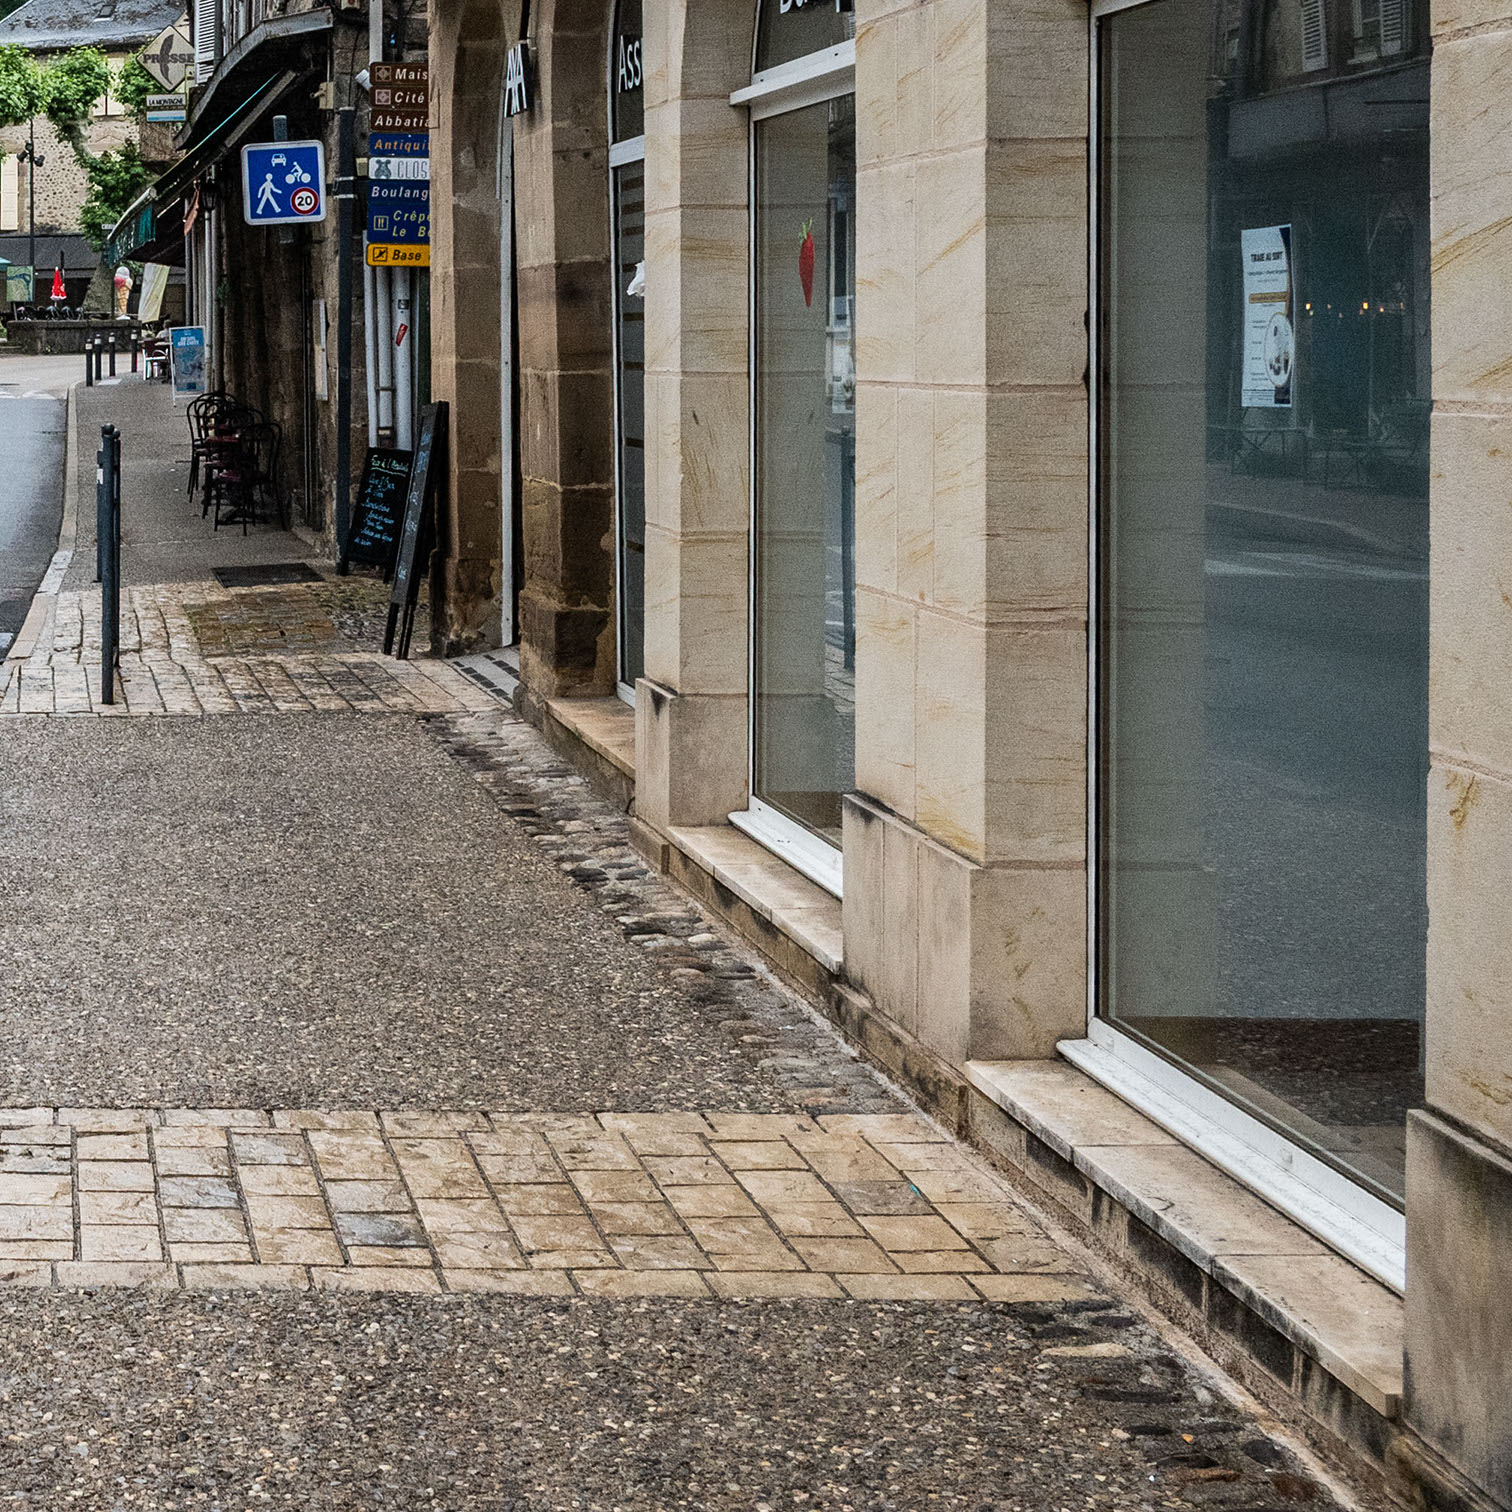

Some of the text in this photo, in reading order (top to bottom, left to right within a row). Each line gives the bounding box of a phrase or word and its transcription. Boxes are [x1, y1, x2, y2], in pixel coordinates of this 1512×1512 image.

[143, 53, 195, 64] PRSSE
[395, 68, 428, 80] Mais
[504, 44, 527, 118] AXA
[155, 98, 183, 106] MONTAGNE
[394, 91, 425, 103] Cité
[374, 139, 429, 153] Antiqui
[397, 160, 428, 179] CLOS
[371, 186, 429, 201] Boulang
[297, 195, 313, 207] 20
[392, 226, 406, 237] Le
[392, 249, 422, 261] Base
